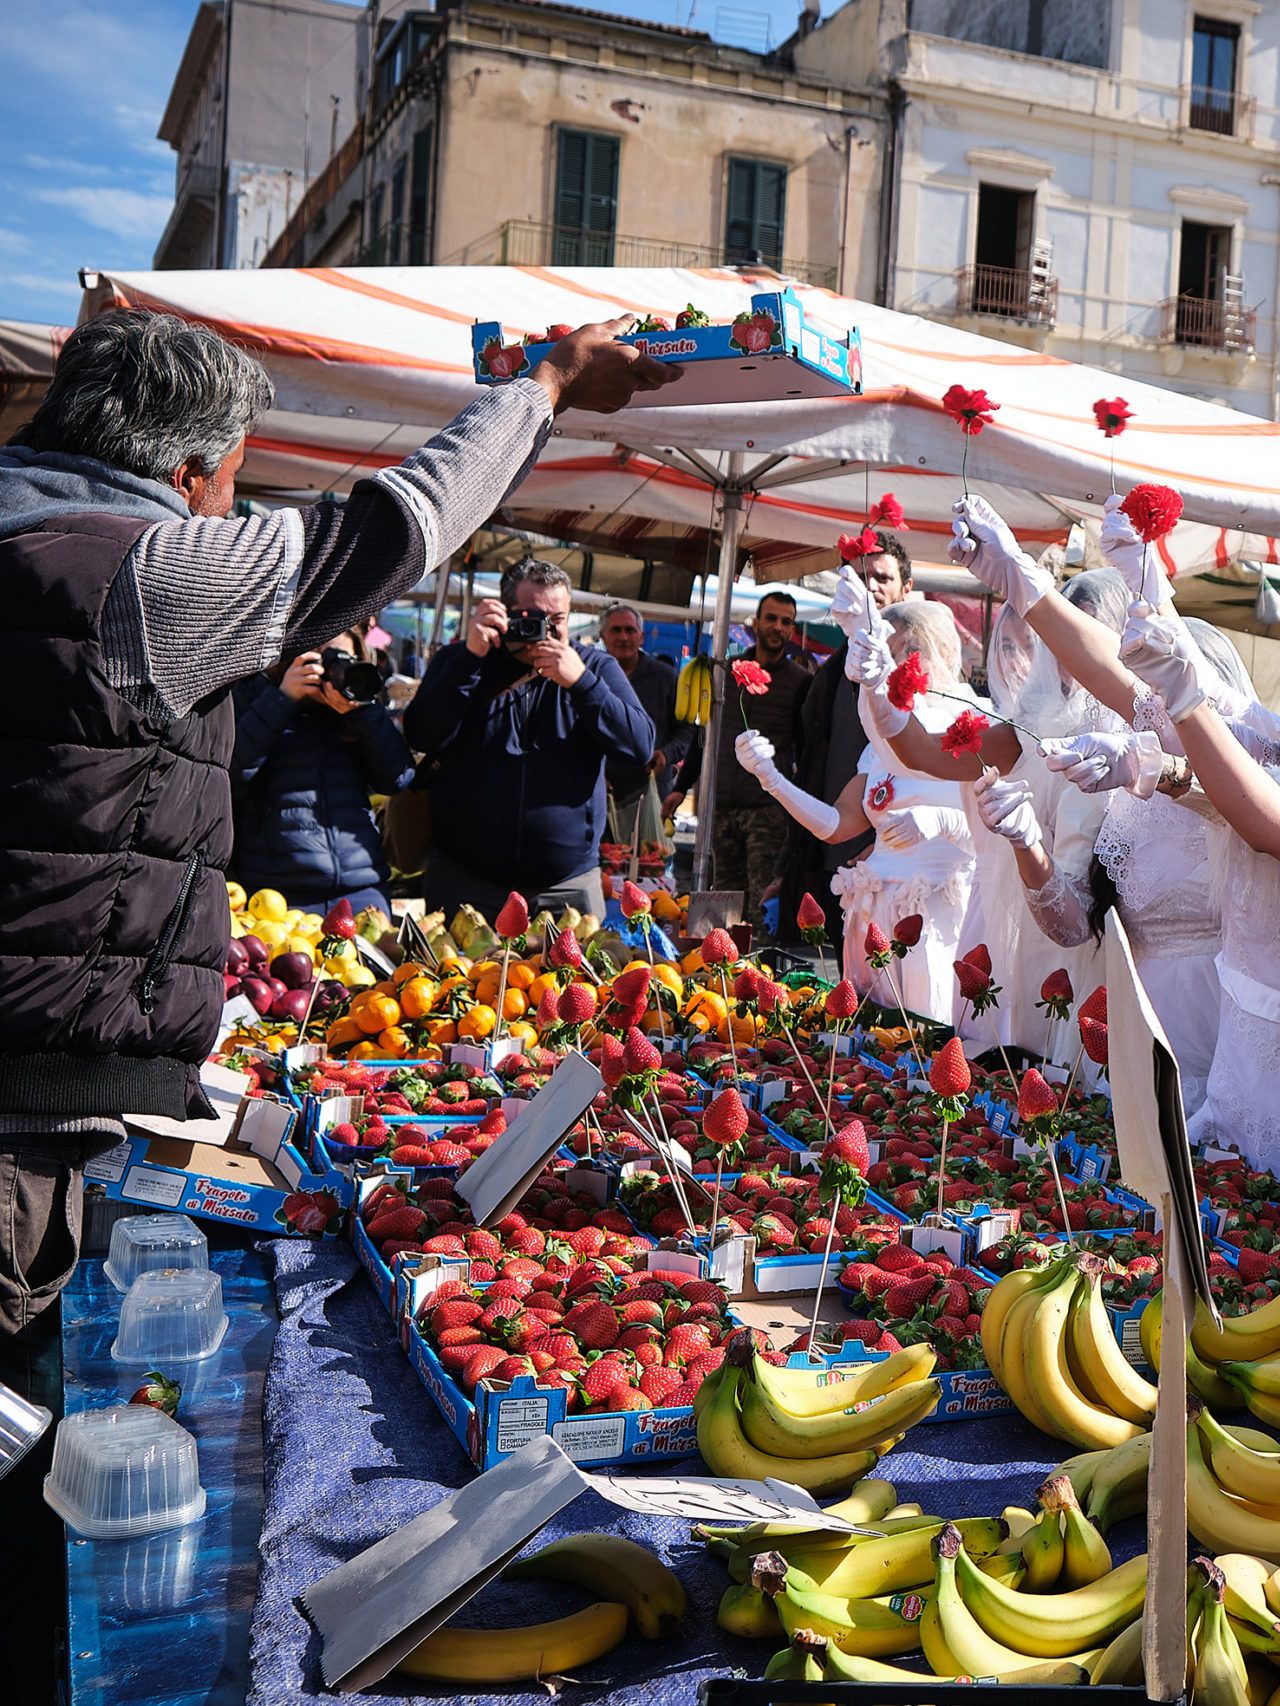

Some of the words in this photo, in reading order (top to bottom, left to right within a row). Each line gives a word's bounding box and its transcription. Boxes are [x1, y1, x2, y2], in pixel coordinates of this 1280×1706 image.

[195, 1178, 251, 1203] Fragole
[185, 1199, 201, 1210] di
[201, 1197, 259, 1223] Marsala
[950, 1374, 1000, 1396] Frago
[946, 1400, 961, 1413] di
[636, 1412, 697, 1437] Fragol
[632, 1441, 650, 1455] di
[653, 1434, 698, 1454] Mars
